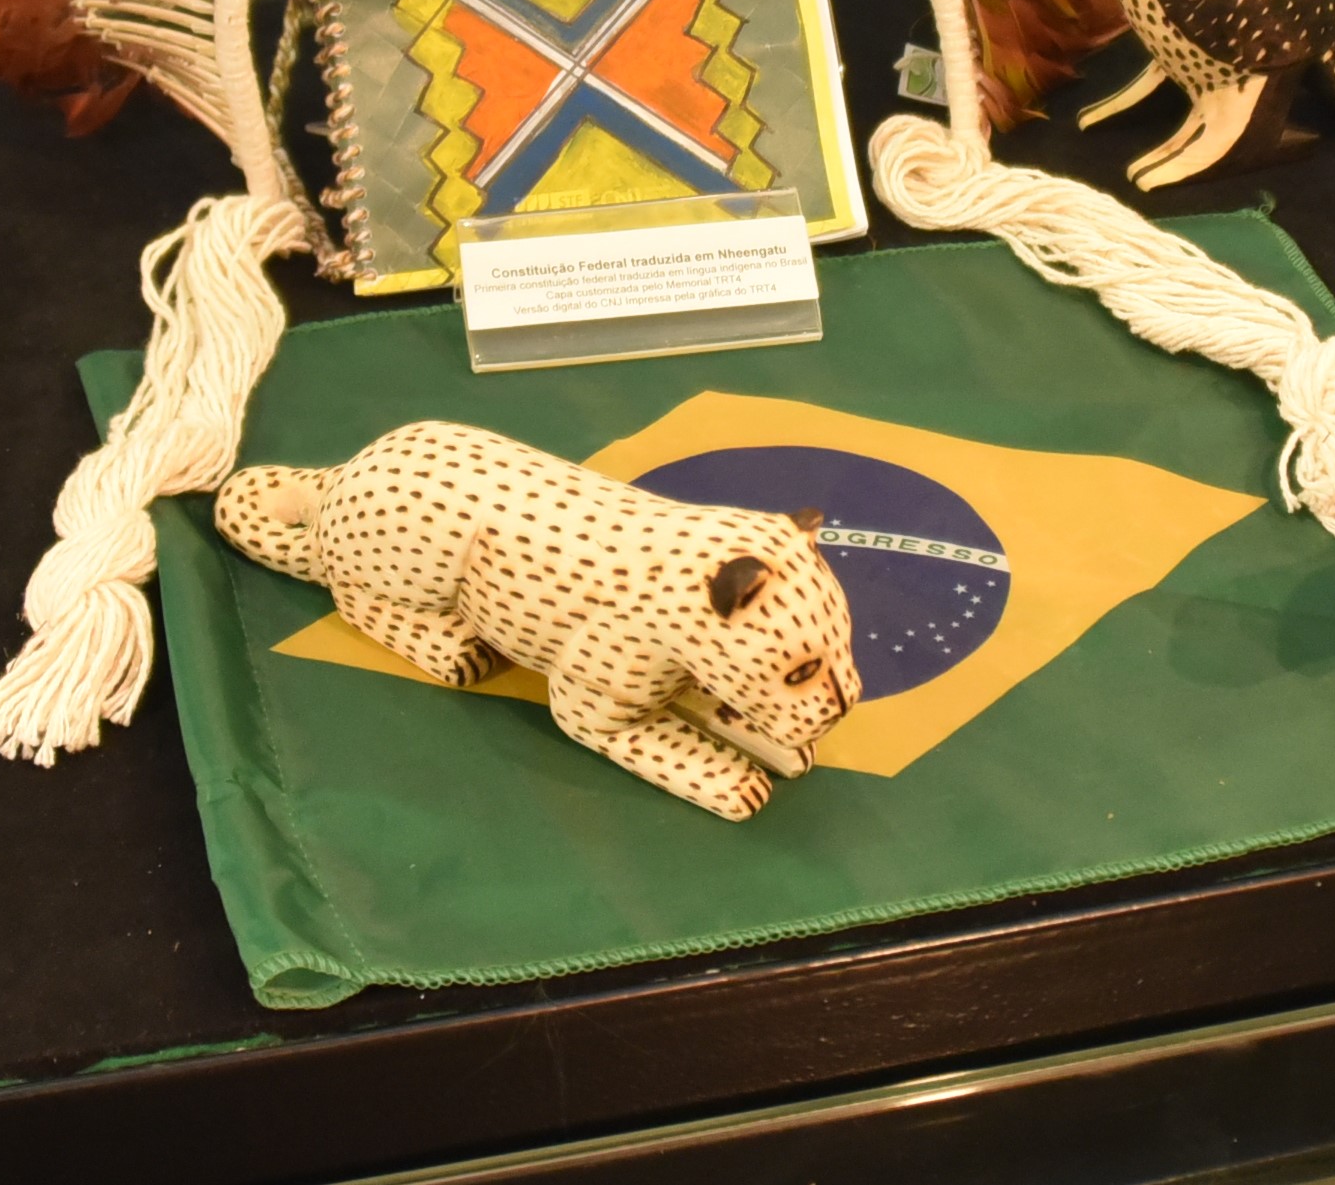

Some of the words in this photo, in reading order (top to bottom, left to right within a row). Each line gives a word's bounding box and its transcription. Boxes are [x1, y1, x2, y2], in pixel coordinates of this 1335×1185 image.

[474, 283, 516, 293] Primeira
[520, 277, 579, 290] constituição
[582, 273, 616, 284] federal
[619, 269, 665, 281] traduzida
[668, 269, 684, 277] em
[780, 256, 808, 268] Brasil
[491, 263, 575, 280] Constituição
[578, 258, 627, 272] Federal
[631, 253, 691, 268] traduzida
[695, 252, 714, 261] em
[718, 245, 787, 259] Nheengatu
[585, 300, 597, 309] do
[674, 291, 695, 302] pela
[734, 286, 746, 295] do
[750, 283, 777, 293] TRT4
[642, 281, 663, 292] pelo
[666, 277, 712, 289] Memorial
[714, 275, 741, 285] TRT4
[820, 529, 998, 566] OGRESSO
